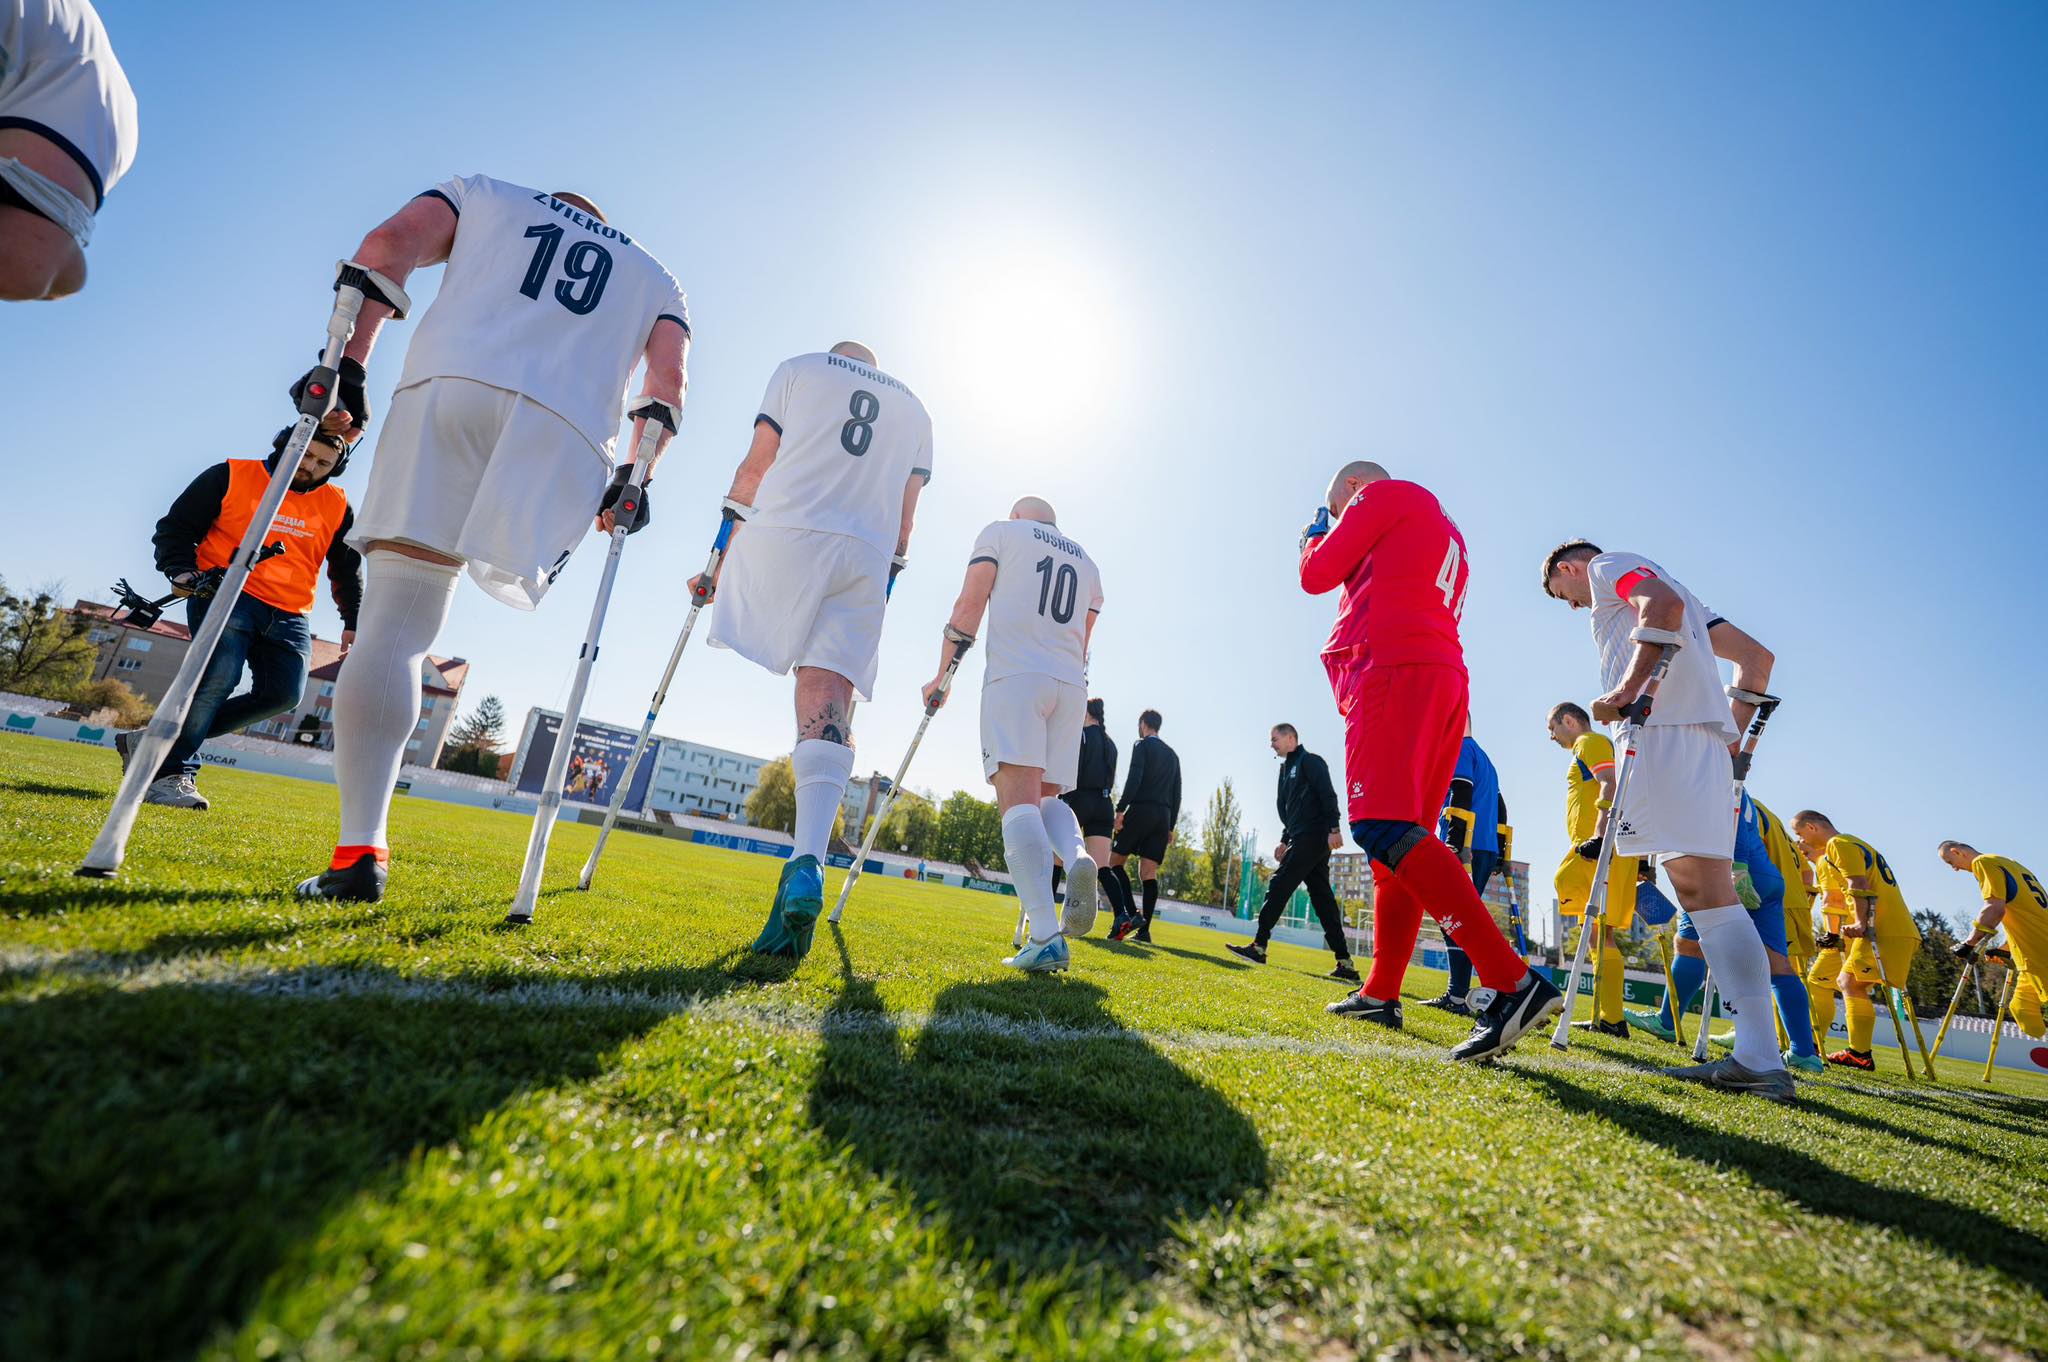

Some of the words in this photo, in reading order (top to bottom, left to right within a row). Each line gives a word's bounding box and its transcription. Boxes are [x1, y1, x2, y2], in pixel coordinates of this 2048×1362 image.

[532, 191, 633, 246] ZVIEKOV
[519, 223, 613, 316] 19
[840, 389, 880, 457] 8
[1036, 555, 1078, 624] 10
